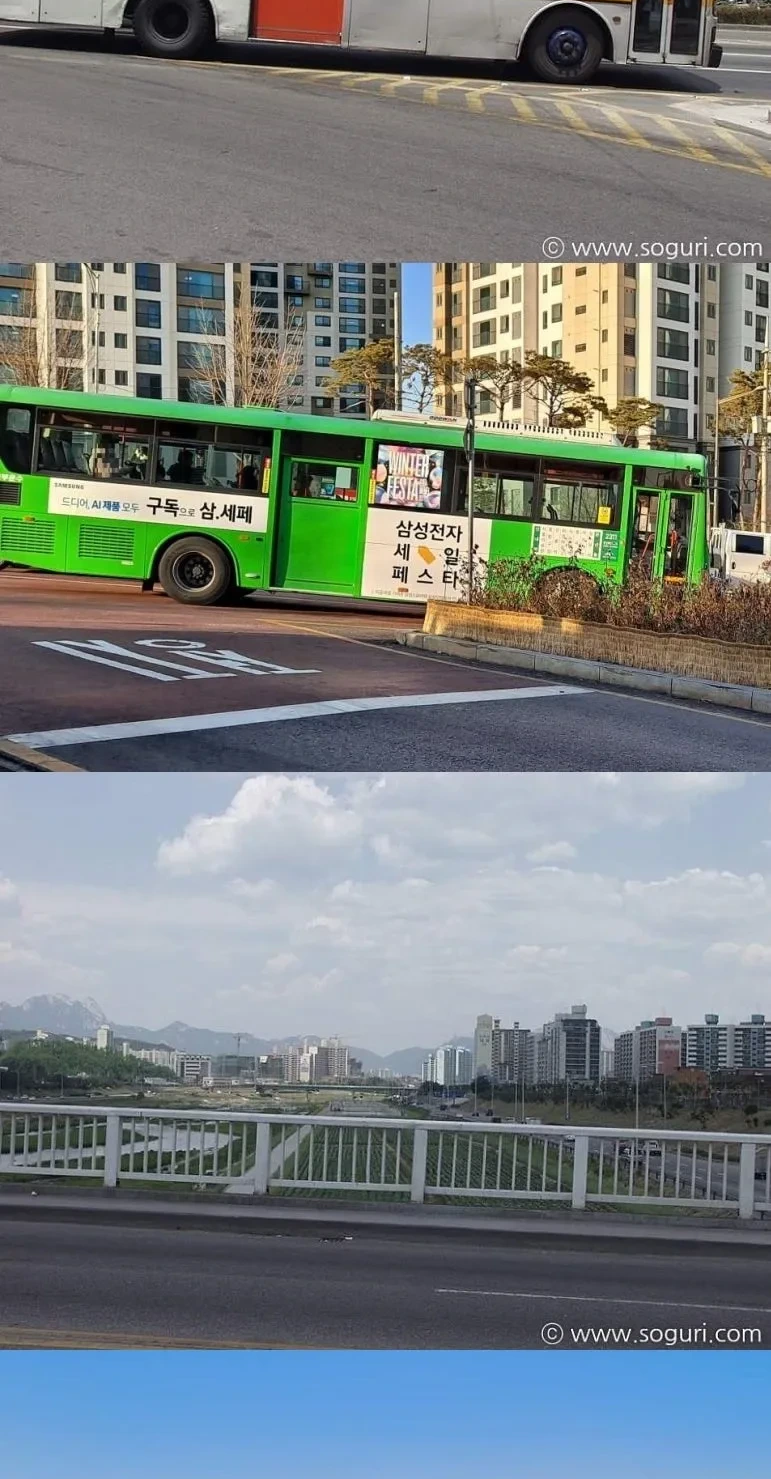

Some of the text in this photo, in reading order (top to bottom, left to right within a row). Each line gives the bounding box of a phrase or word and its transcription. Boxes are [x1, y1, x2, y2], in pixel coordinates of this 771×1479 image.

[388, 449, 430, 478] WINTER
[54, 482, 85, 490] SAMSUNG
[386, 475, 419, 501] FESTA
[61, 496, 253, 524] 드디어, AI 제품 모두 구독으로 삼.세페
[396, 520, 463, 543] 삼성전자
